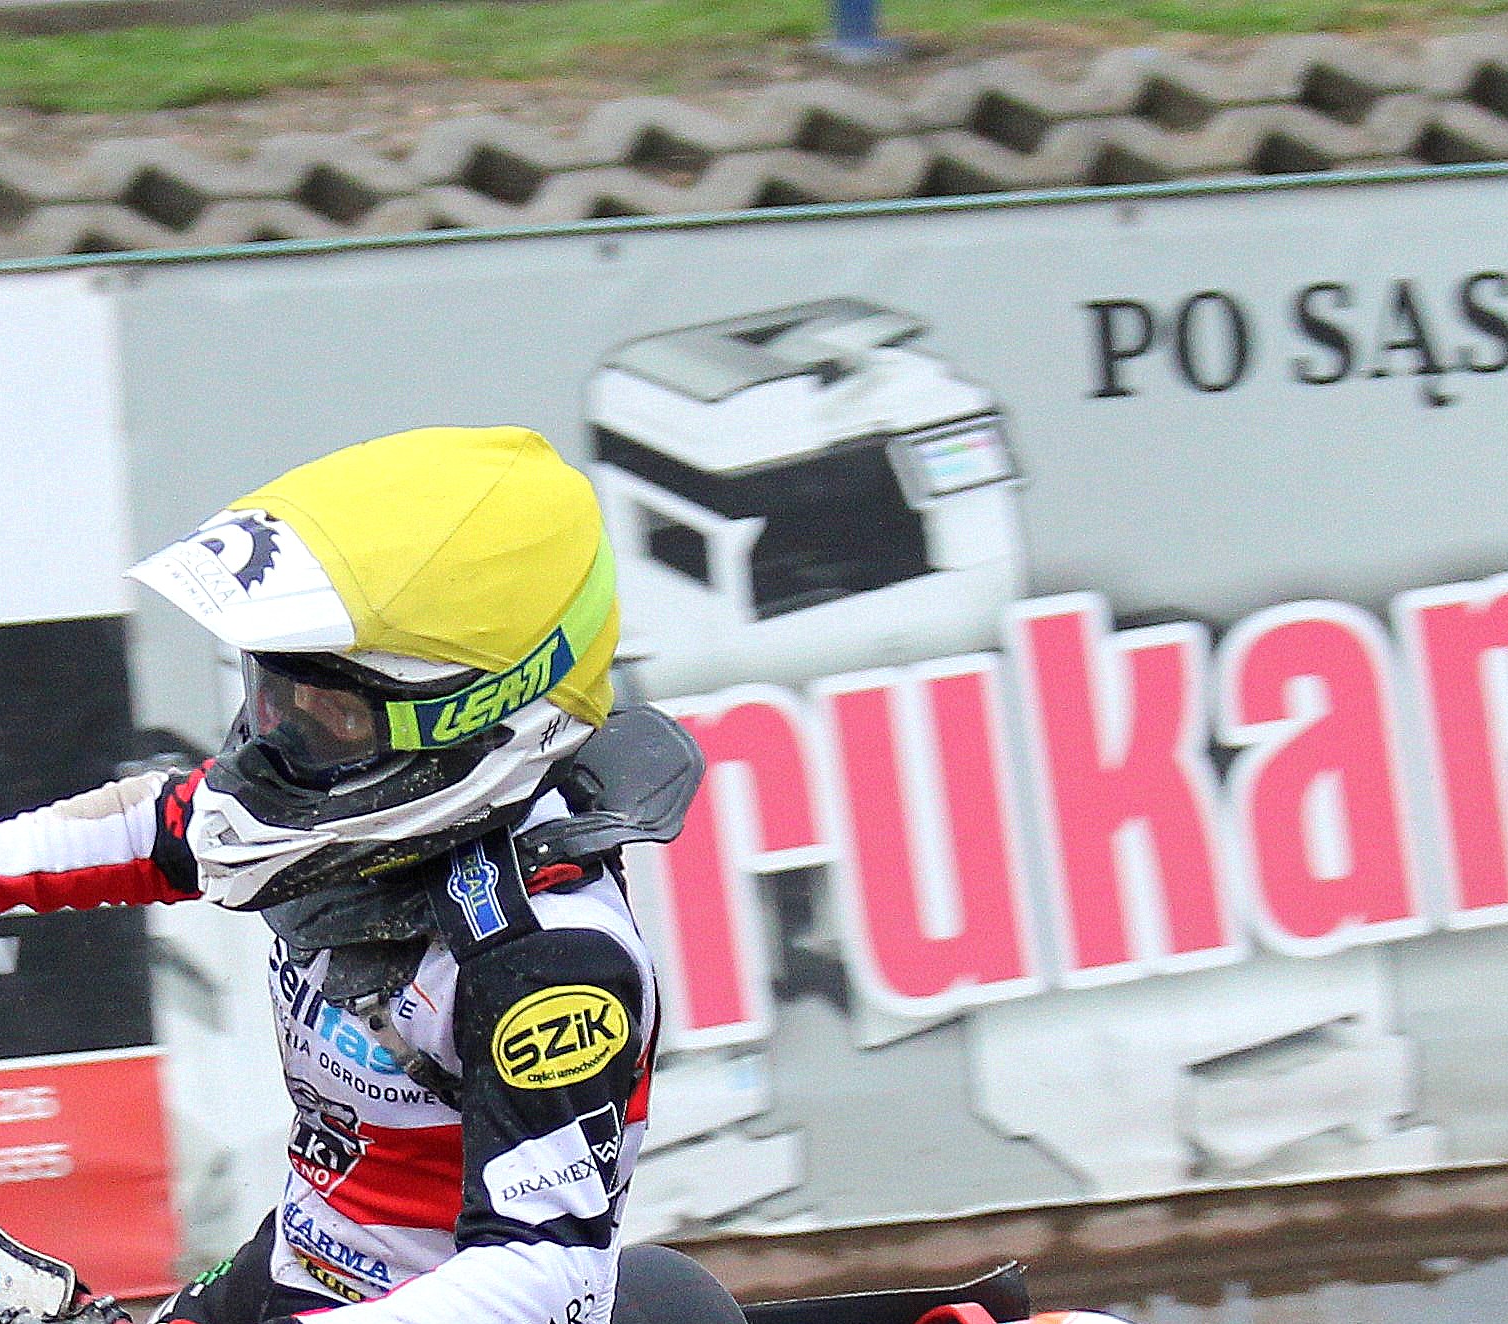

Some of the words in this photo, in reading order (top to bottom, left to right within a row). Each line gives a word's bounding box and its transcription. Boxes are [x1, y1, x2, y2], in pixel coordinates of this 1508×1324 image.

[1079, 290, 1251, 400] PO
[431, 634, 559, 742] LEATT
[319, 1052, 436, 1106] OGRODOWE
